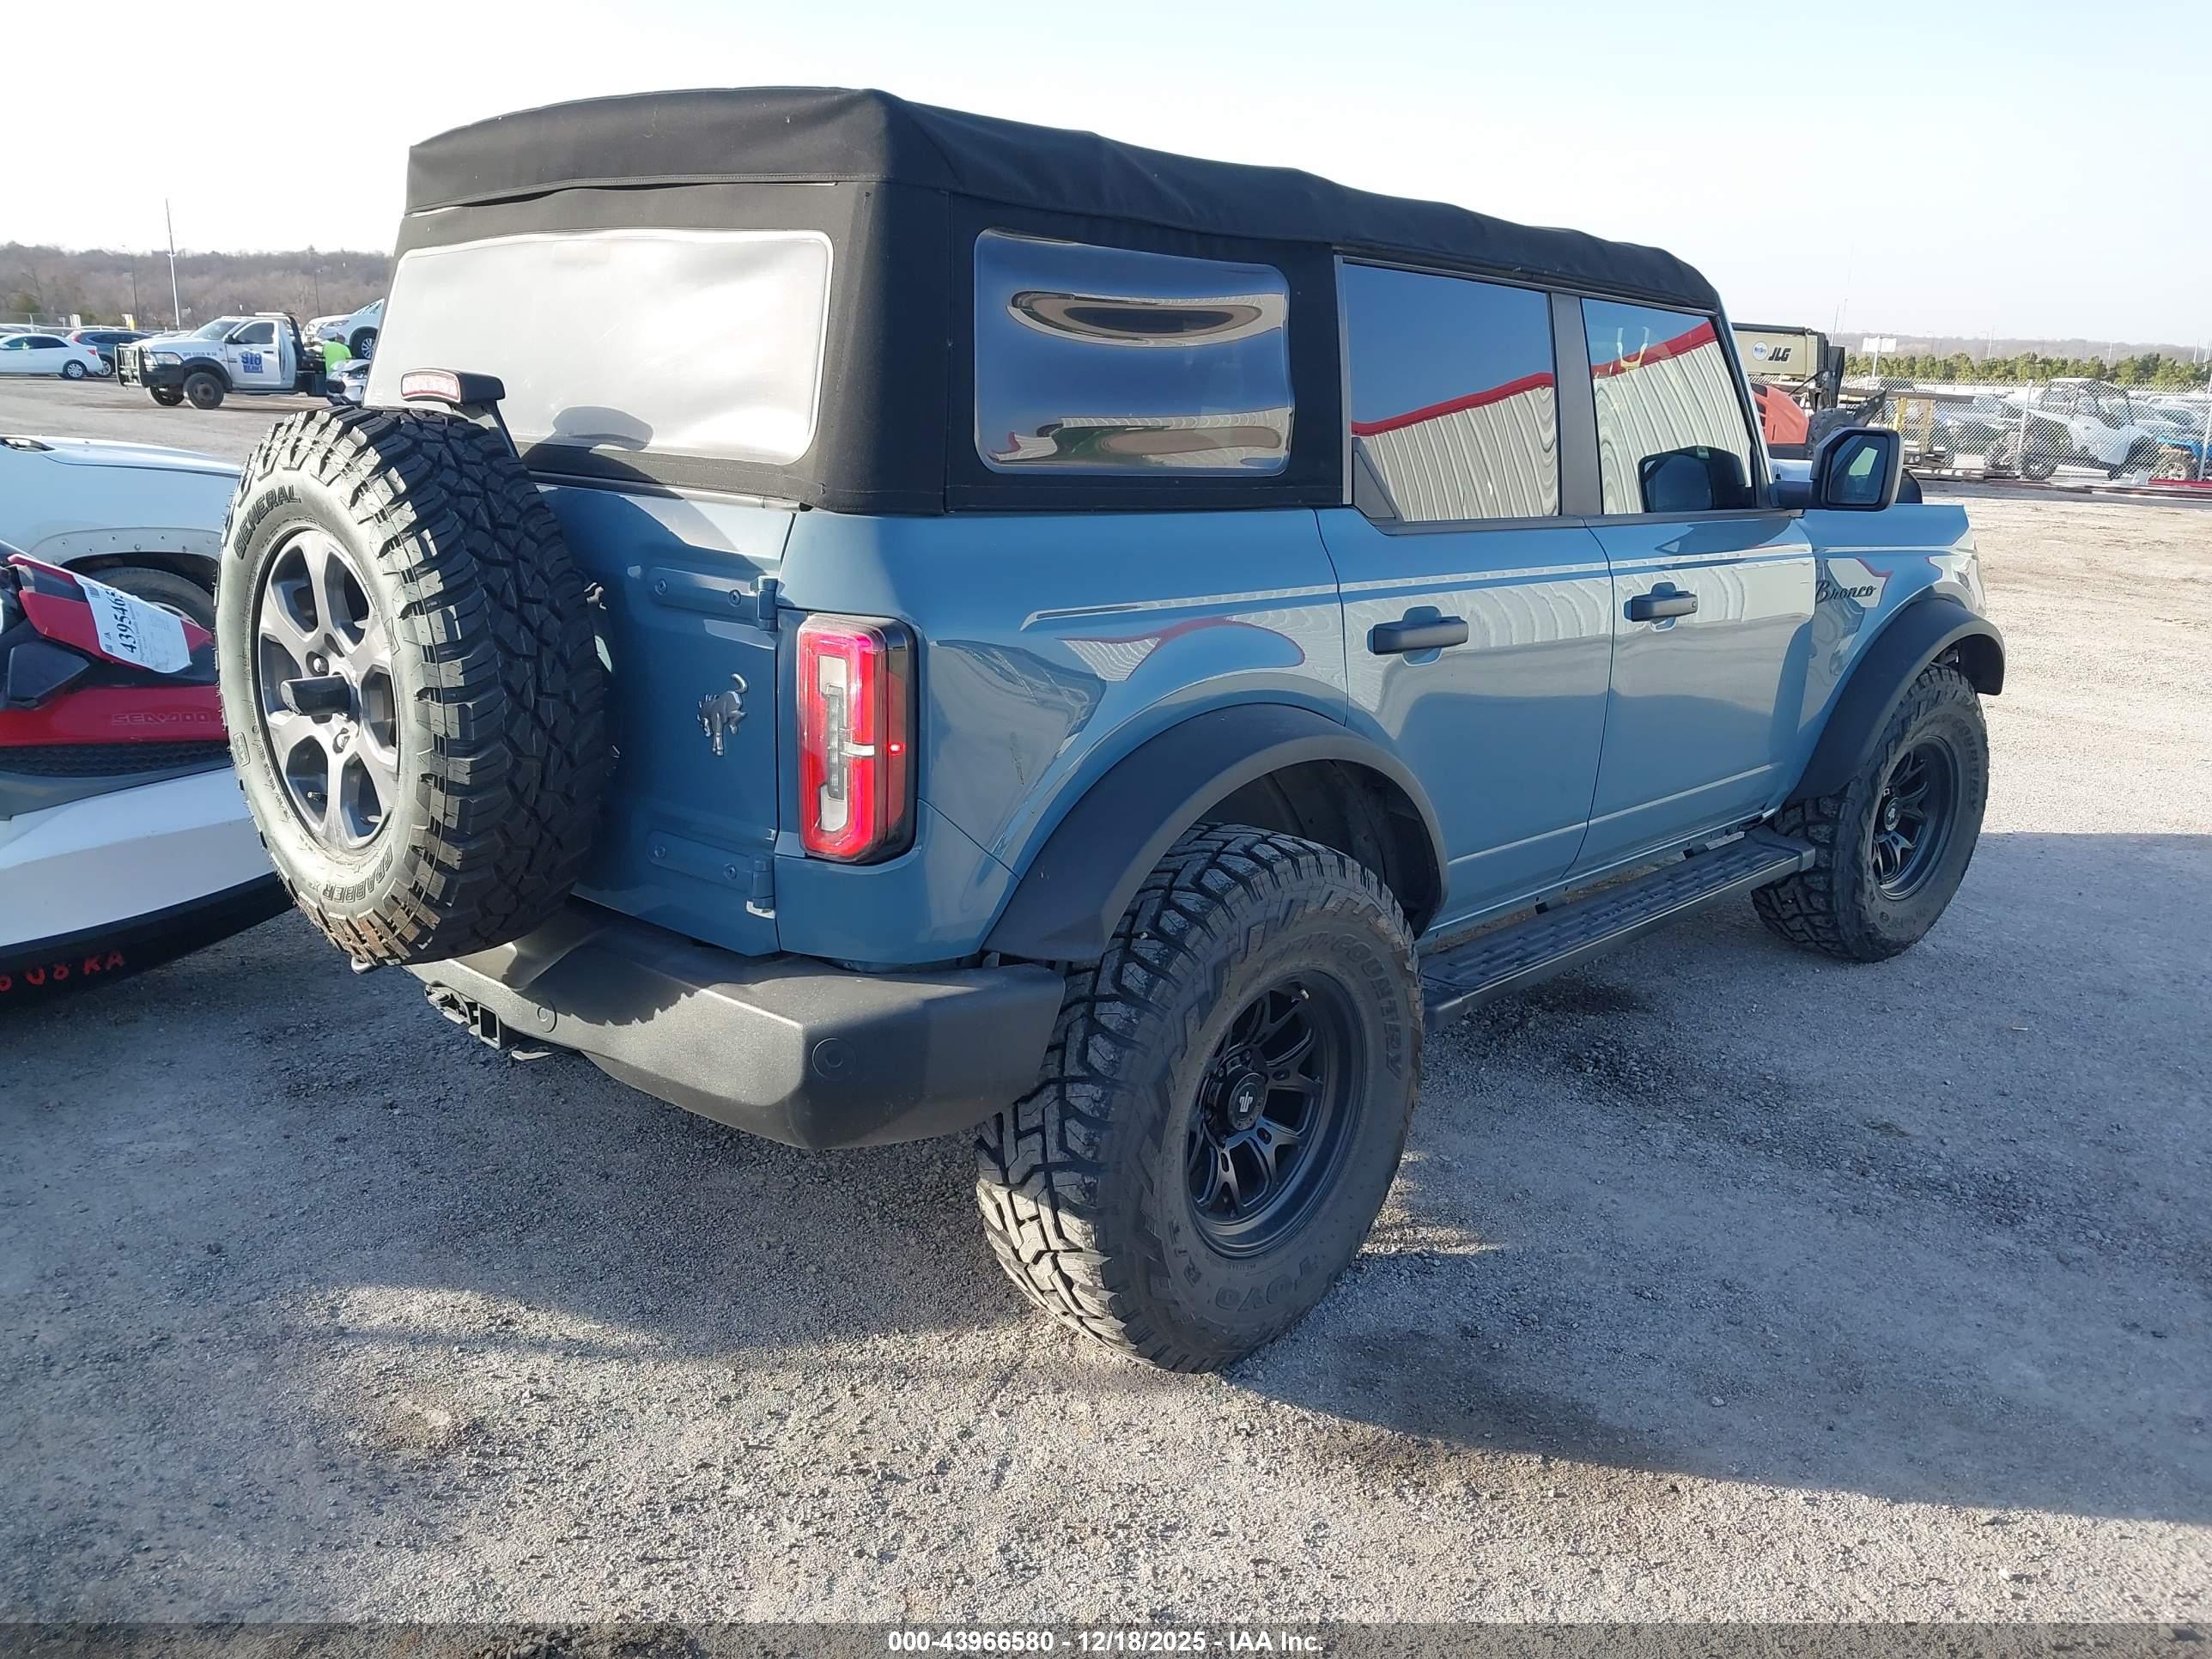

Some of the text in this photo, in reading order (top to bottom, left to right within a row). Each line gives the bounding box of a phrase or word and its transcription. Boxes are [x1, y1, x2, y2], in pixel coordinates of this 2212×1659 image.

[241, 351, 262, 366] 918
[1767, 347, 1791, 362] JLG
[234, 484, 301, 560] GENERAL
[1814, 580, 1877, 605] Bronco
[323, 843, 393, 903] GRABBER
